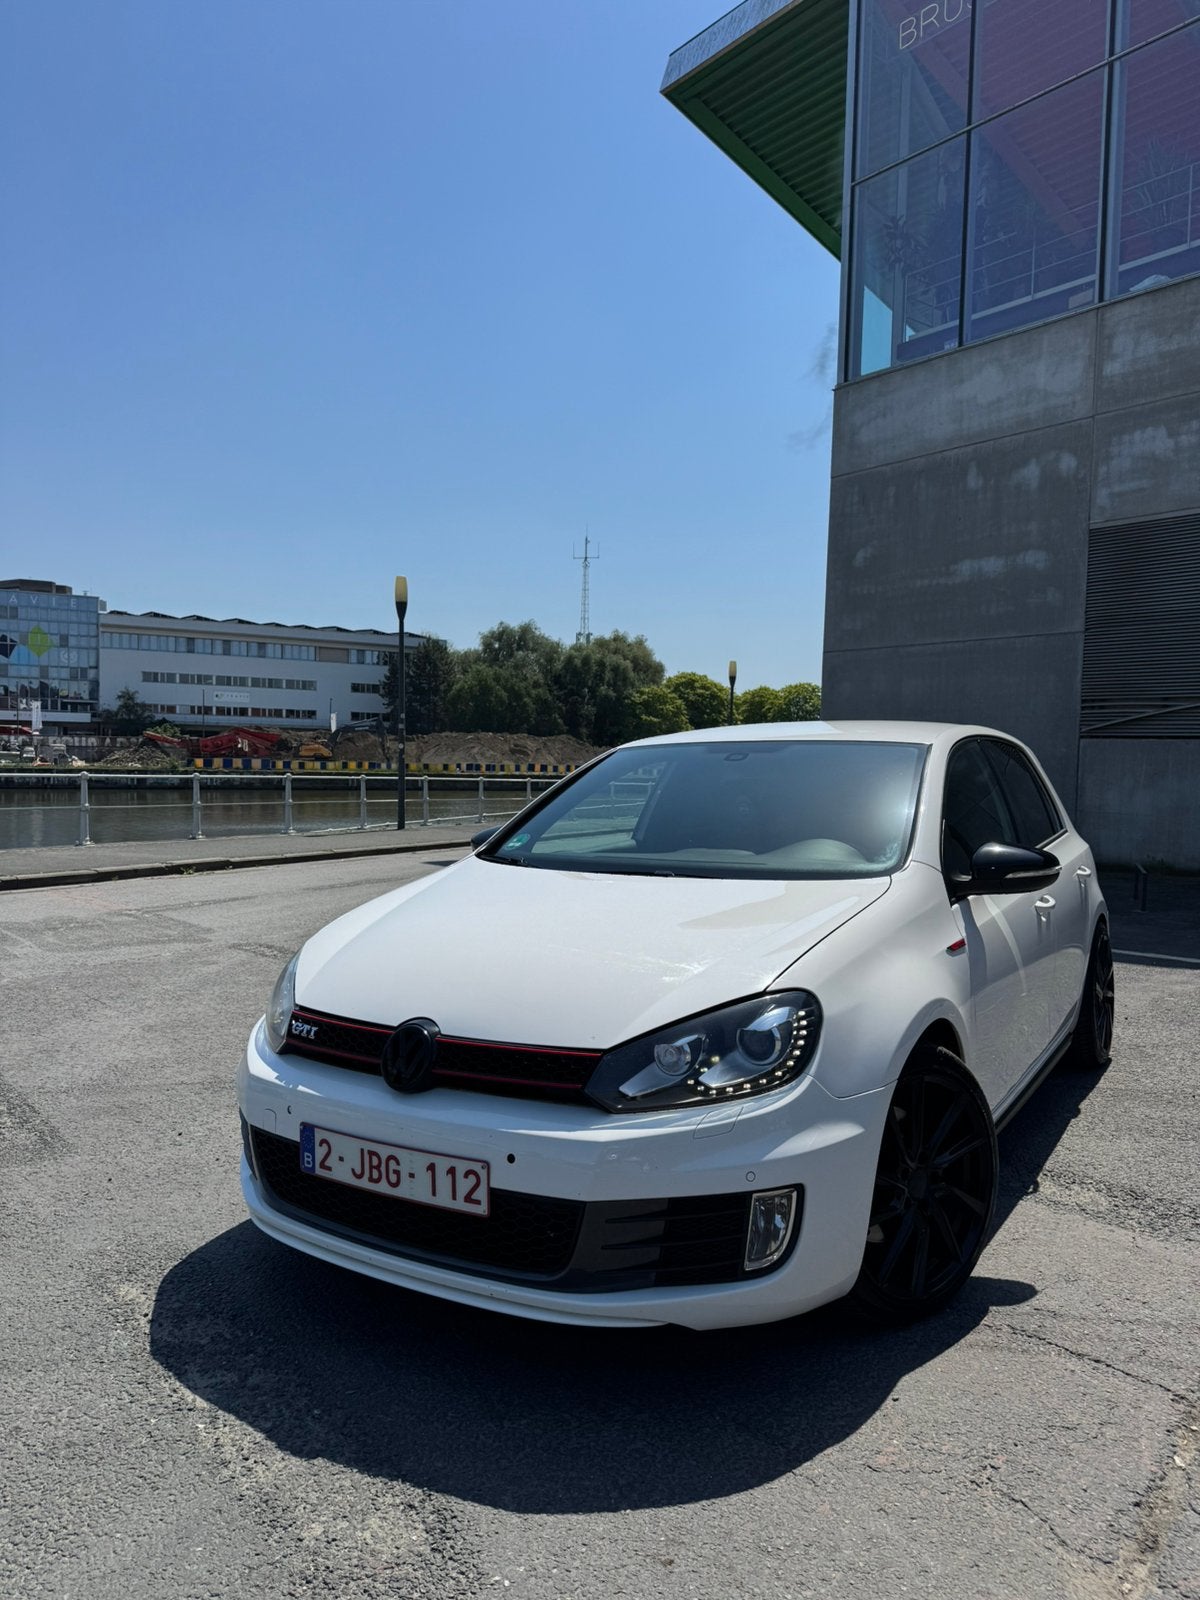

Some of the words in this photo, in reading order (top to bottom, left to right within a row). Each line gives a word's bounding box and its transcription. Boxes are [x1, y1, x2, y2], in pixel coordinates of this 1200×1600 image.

[899, 0, 971, 50] BRU
[291, 1020, 318, 1039] GTI
[304, 1152, 313, 1168] B
[318, 1138, 482, 1206] 2-JBG-112
